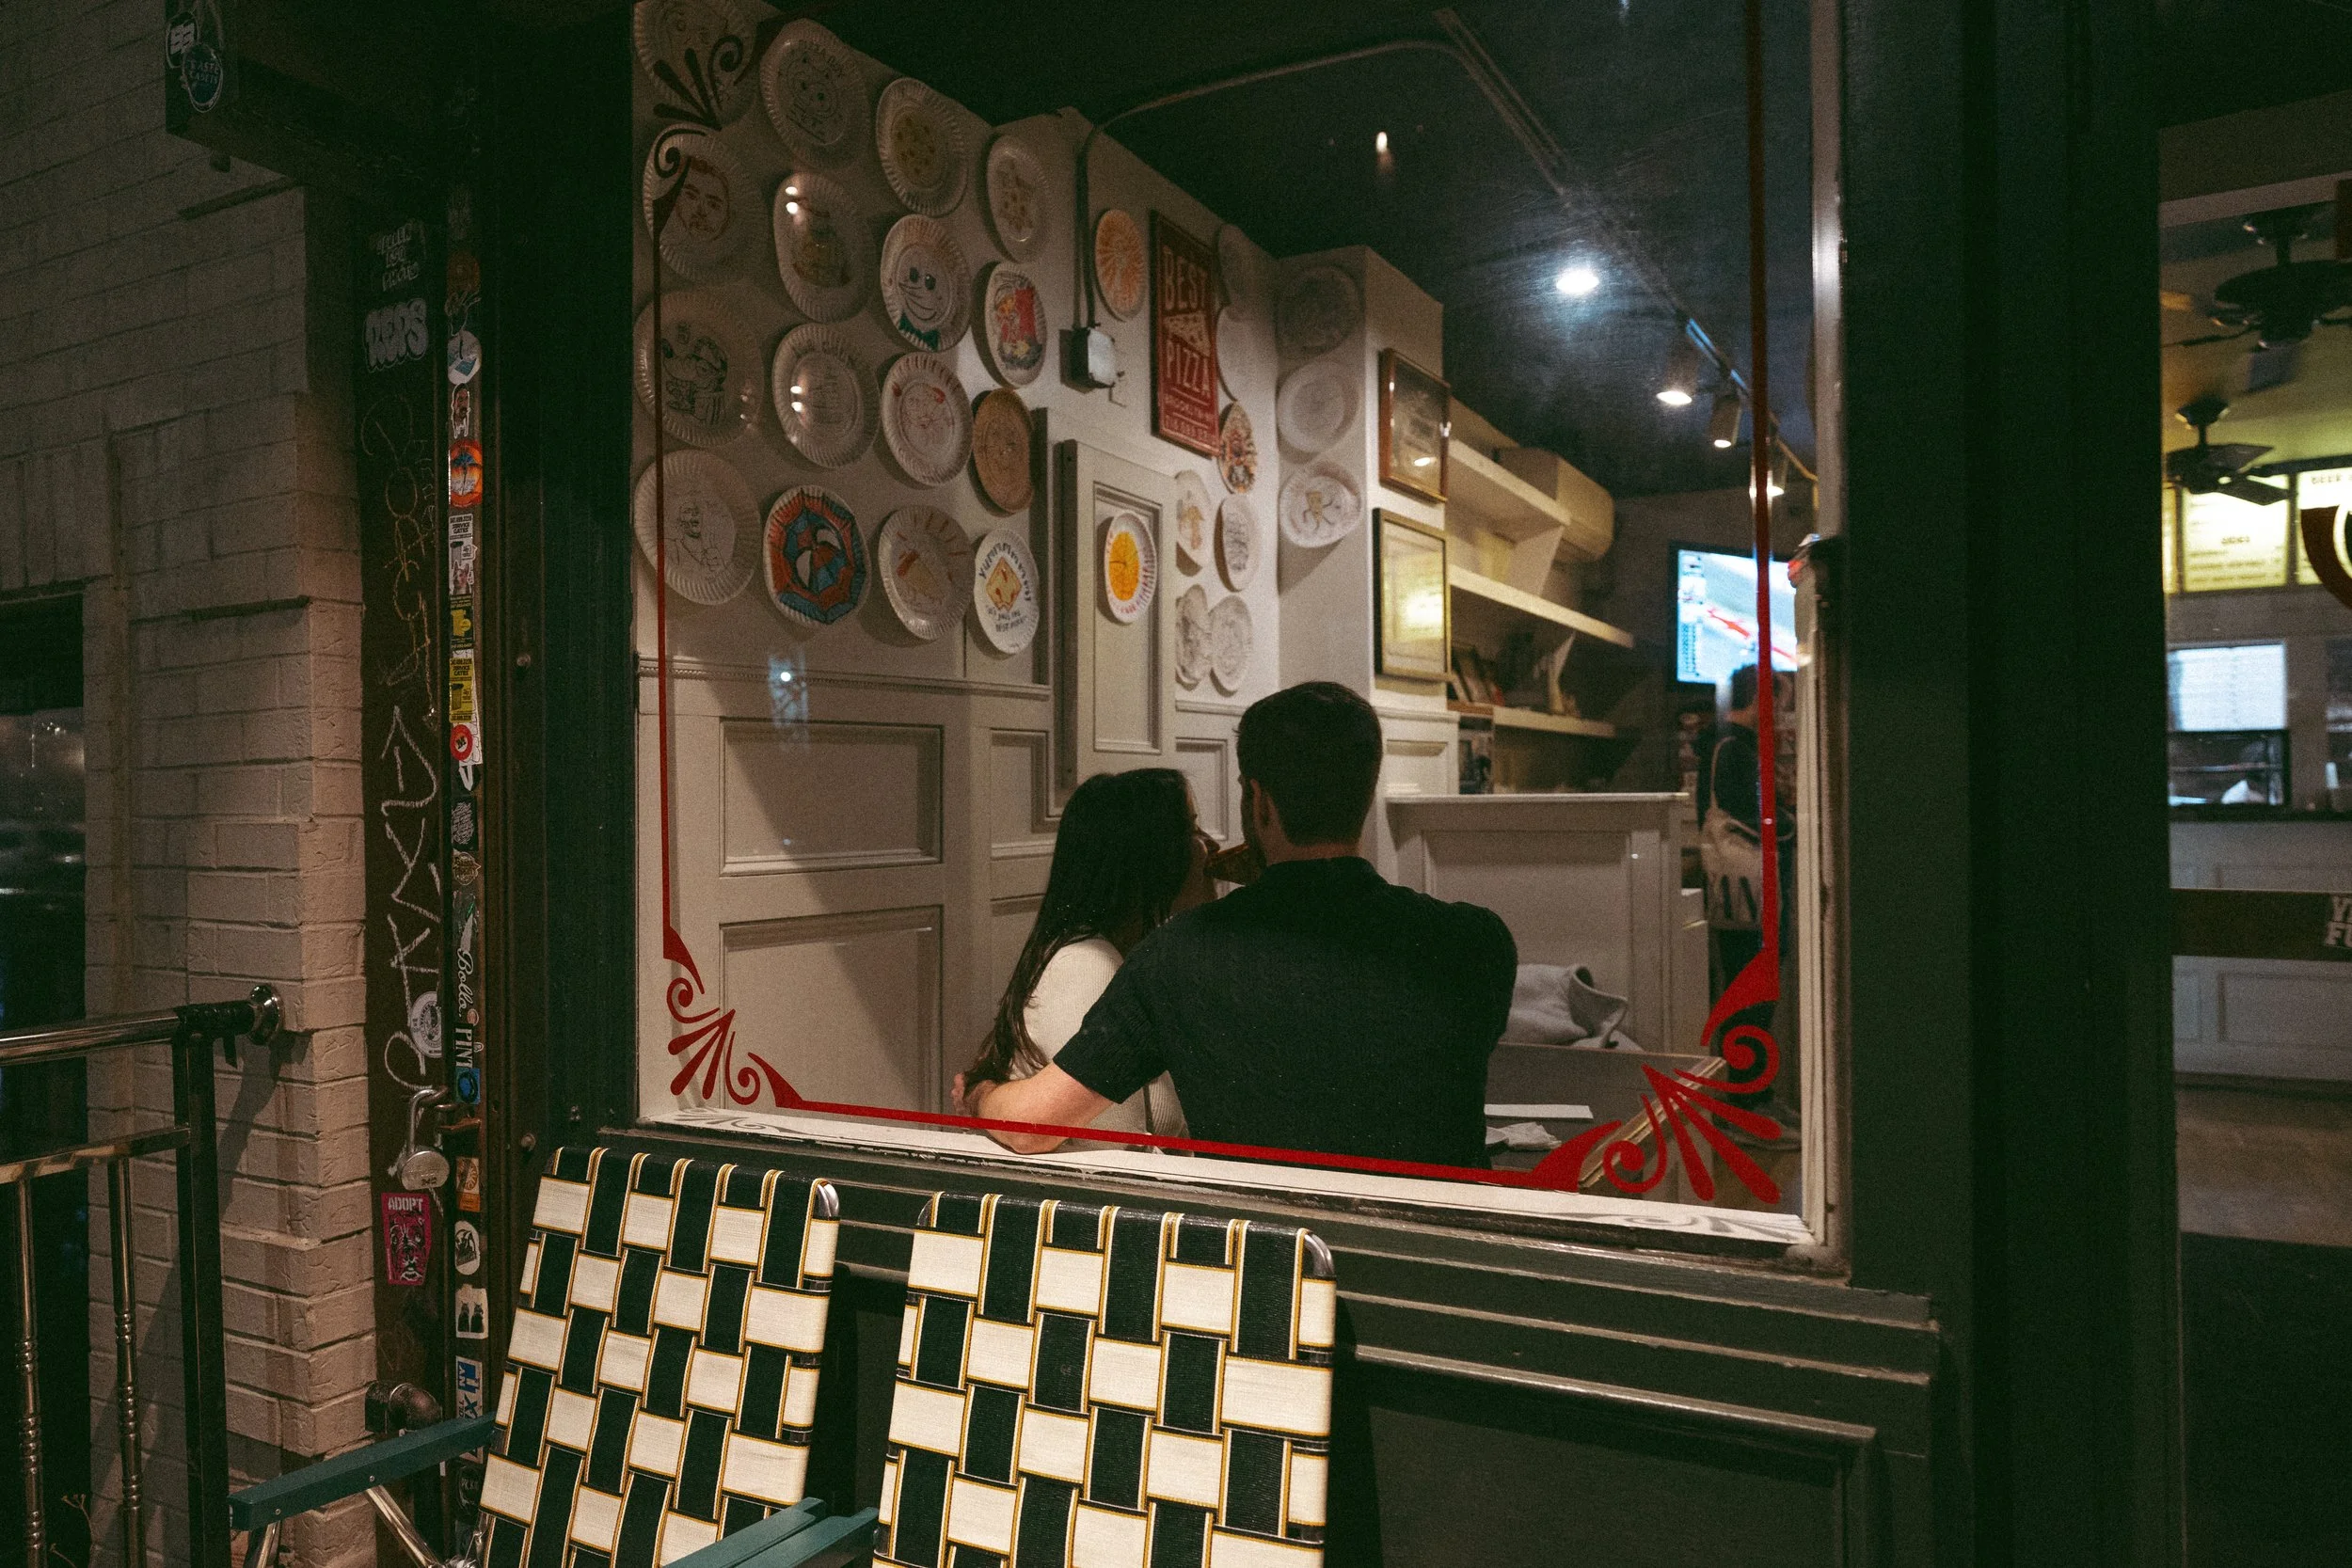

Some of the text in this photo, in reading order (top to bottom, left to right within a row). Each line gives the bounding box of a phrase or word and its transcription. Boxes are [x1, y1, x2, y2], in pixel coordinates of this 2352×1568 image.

[1163, 246, 1208, 310] BEST
[1166, 341, 1211, 396] PIZZA
[388, 1196, 423, 1212] ADOPT
